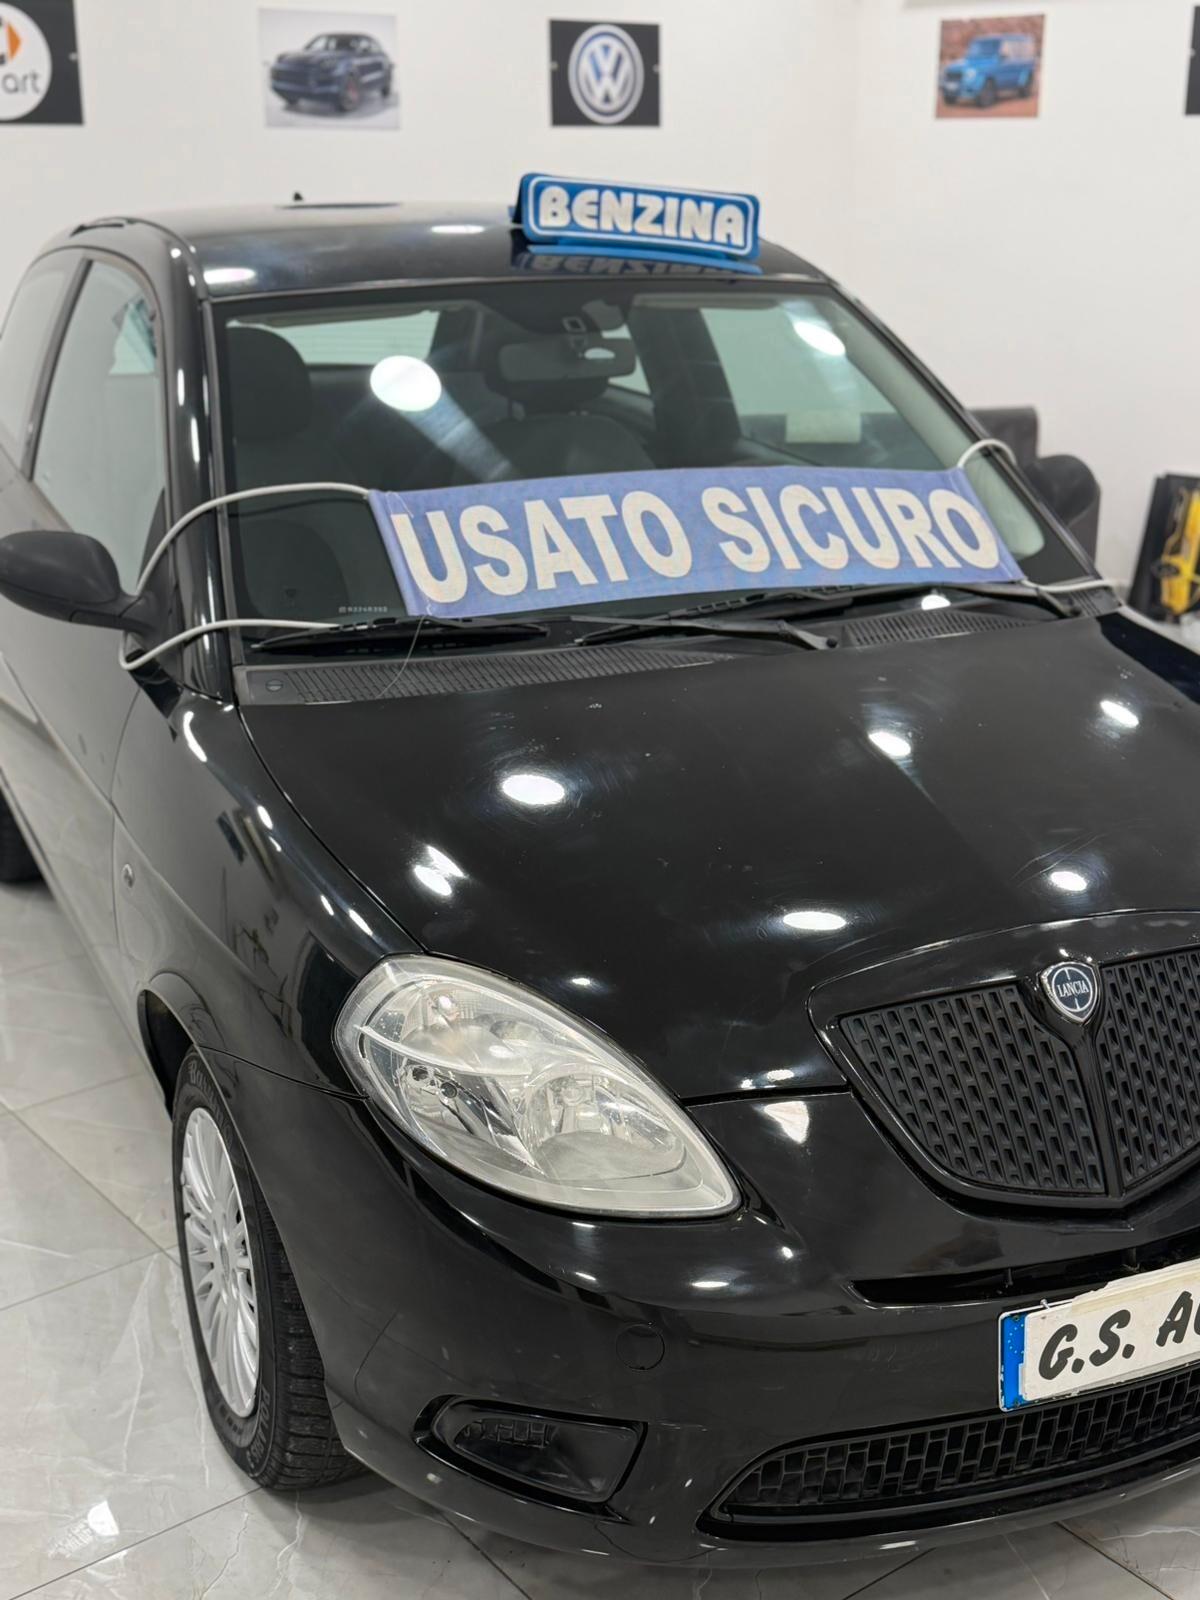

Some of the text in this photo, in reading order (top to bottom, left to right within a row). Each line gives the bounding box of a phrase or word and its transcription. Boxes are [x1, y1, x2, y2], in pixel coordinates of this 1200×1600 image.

[538, 184, 746, 248] BENZINA
[391, 484, 1000, 603] USATO SICURO
[1057, 980, 1090, 998] LANCIA
[1038, 1290, 1200, 1381] G.S. A
